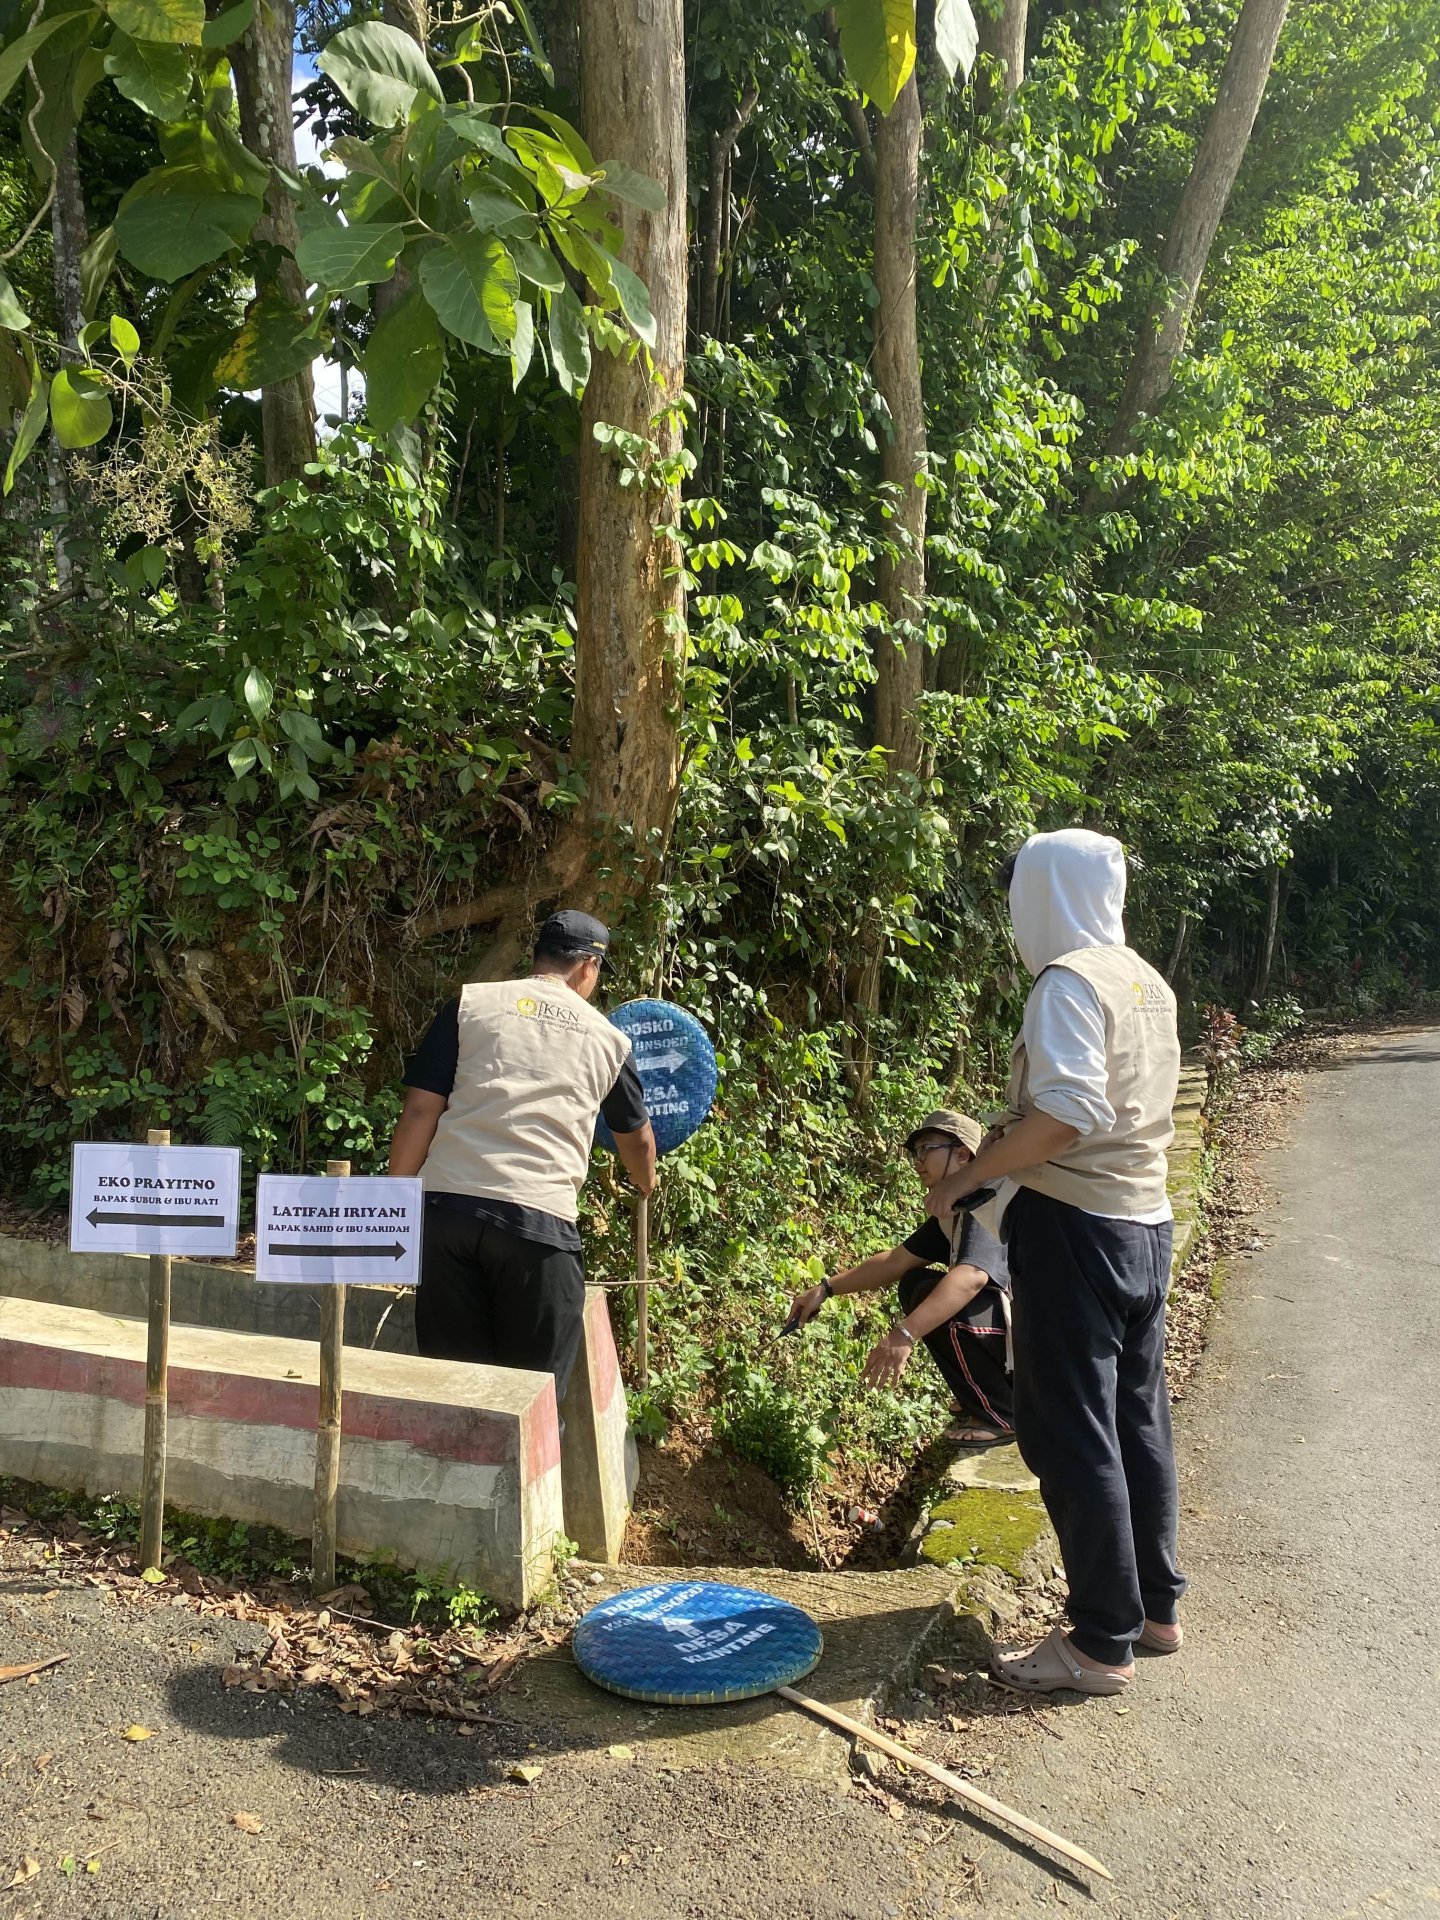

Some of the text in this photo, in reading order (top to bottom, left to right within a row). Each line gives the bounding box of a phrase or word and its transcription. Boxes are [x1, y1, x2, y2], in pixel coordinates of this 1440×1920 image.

[543, 1003, 580, 1022] KKN
[643, 1084, 679, 1102] ESA
[644, 1100, 689, 1117] NTING
[98, 1176, 216, 1190] EKO PRAYITNO
[93, 1194, 219, 1206] BAPAK SUBUR & IBU RATI
[273, 1205, 407, 1218] LATIFAH IRIYANI
[267, 1223, 410, 1233] BAPAK SAHID & IBU SARIDAH
[601, 1585, 670, 1616] POSKO
[673, 1621, 747, 1653] DESA
[681, 1623, 777, 1664] KLINTING
